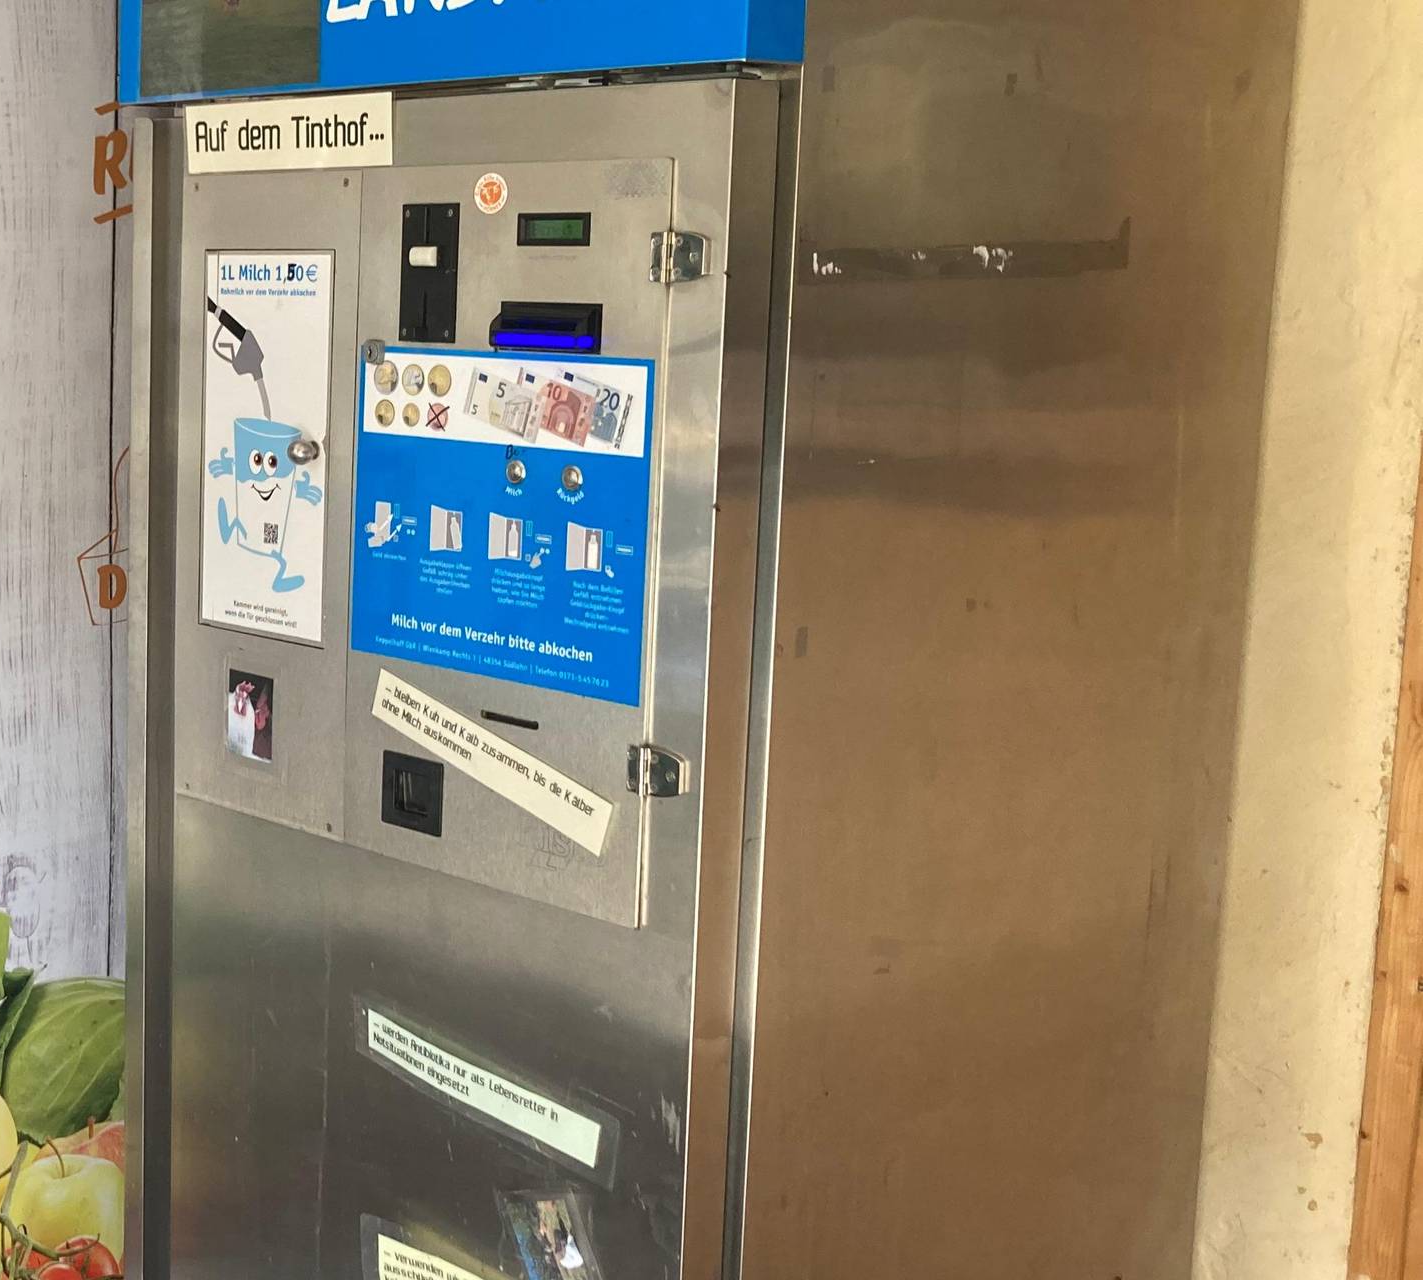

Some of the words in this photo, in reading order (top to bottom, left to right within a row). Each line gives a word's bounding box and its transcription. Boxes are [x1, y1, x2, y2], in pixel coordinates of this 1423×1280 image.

[195, 120, 228, 152] Auf
[238, 119, 281, 151] dem
[291, 112, 385, 149] Tinthof...
[221, 264, 235, 281] 1L
[238, 264, 271, 281] Milch
[547, 382, 562, 401] 10
[601, 388, 621, 412] 20
[505, 485, 523, 497] Milch
[391, 613, 418, 630] Milch
[420, 621, 437, 633] vor
[439, 622, 462, 638] dem
[464, 626, 506, 646] Verzehr
[508, 634, 535, 652] bitte
[538, 640, 593, 663] abkochen
[381, 698, 400, 716] ohne
[401, 708, 422, 730] Milch
[423, 724, 472, 761] auskommen
[394, 686, 421, 711] bleiben
[423, 704, 439, 723] Kuh
[441, 718, 458, 734] und
[458, 726, 479, 747] Kalb
[533, 770, 546, 787] bis
[549, 782, 562, 797] die
[373, 1031, 425, 1073] Notsituationen
[427, 1065, 469, 1097] eingesetzt
[382, 1023, 408, 1047] werden
[411, 1038, 450, 1070] Antibiotika
[453, 1064, 468, 1079] nur
[471, 1073, 485, 1087] als
[489, 1078, 546, 1115] Lebensretter
[550, 1107, 560, 1122] in
